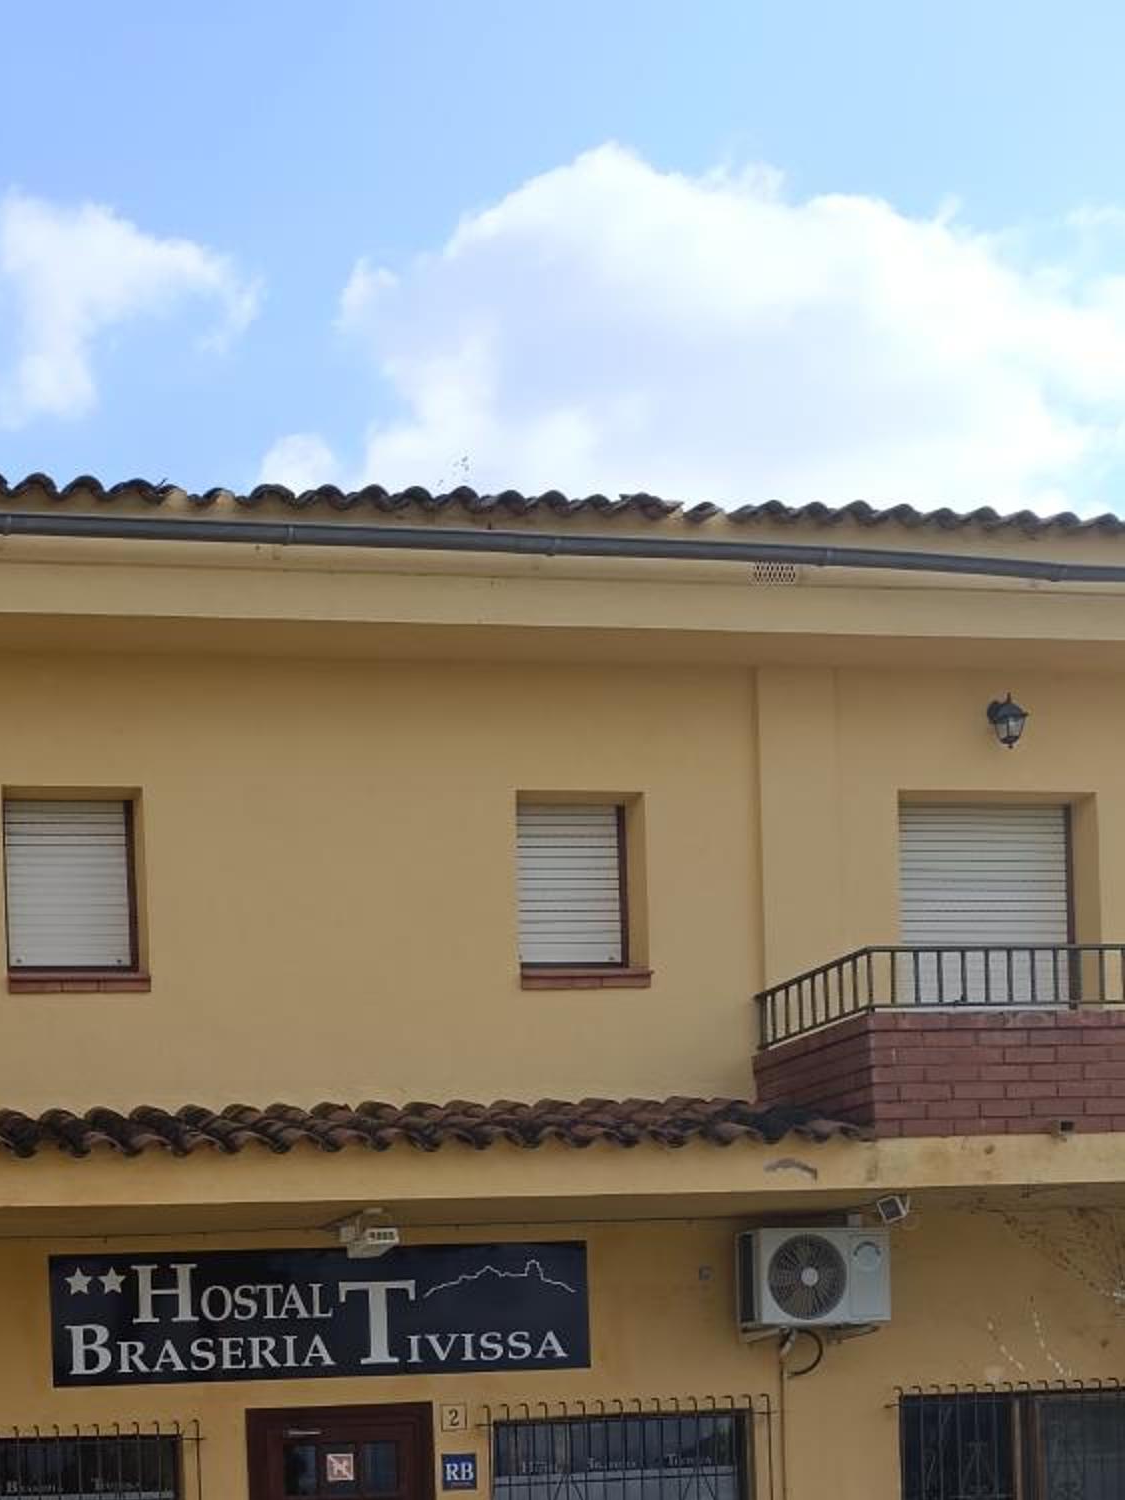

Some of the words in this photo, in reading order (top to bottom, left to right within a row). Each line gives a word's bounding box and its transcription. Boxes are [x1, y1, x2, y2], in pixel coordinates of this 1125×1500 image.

[131, 1263, 333, 1324] HOSTAL
[65, 1323, 336, 1374] BRASERIA
[339, 1279, 568, 1365] TIVISSA
[448, 1408, 459, 1427] 2
[445, 1462, 475, 1481] RB
